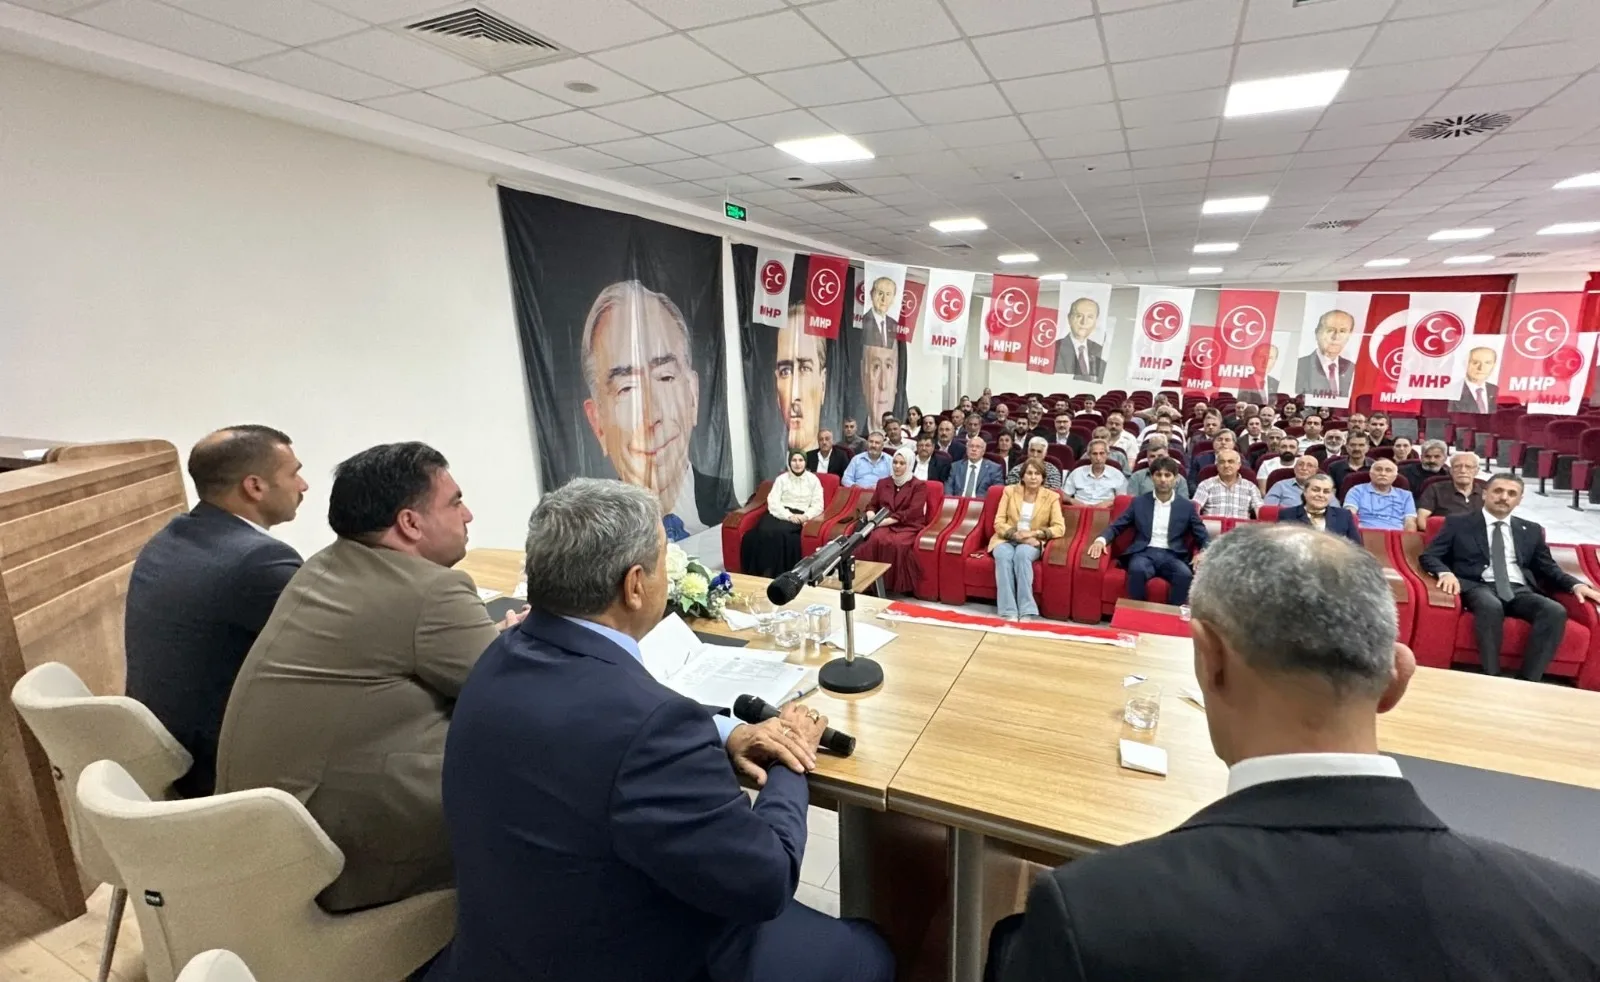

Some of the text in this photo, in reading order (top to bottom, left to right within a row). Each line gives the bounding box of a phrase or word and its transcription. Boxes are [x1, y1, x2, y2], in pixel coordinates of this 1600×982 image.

[760, 305, 782, 318] MHP
[809, 316, 832, 329] MHP
[931, 335, 957, 347] MHP
[993, 339, 1022, 353] MHP
[1029, 355, 1050, 367] MHP
[1140, 356, 1173, 370] MHP
[1218, 364, 1256, 379] MHP
[1186, 378, 1213, 390] MHP
[1408, 374, 1451, 388] MHP
[1508, 376, 1557, 391] MHP
[1380, 391, 1412, 404] MHP
